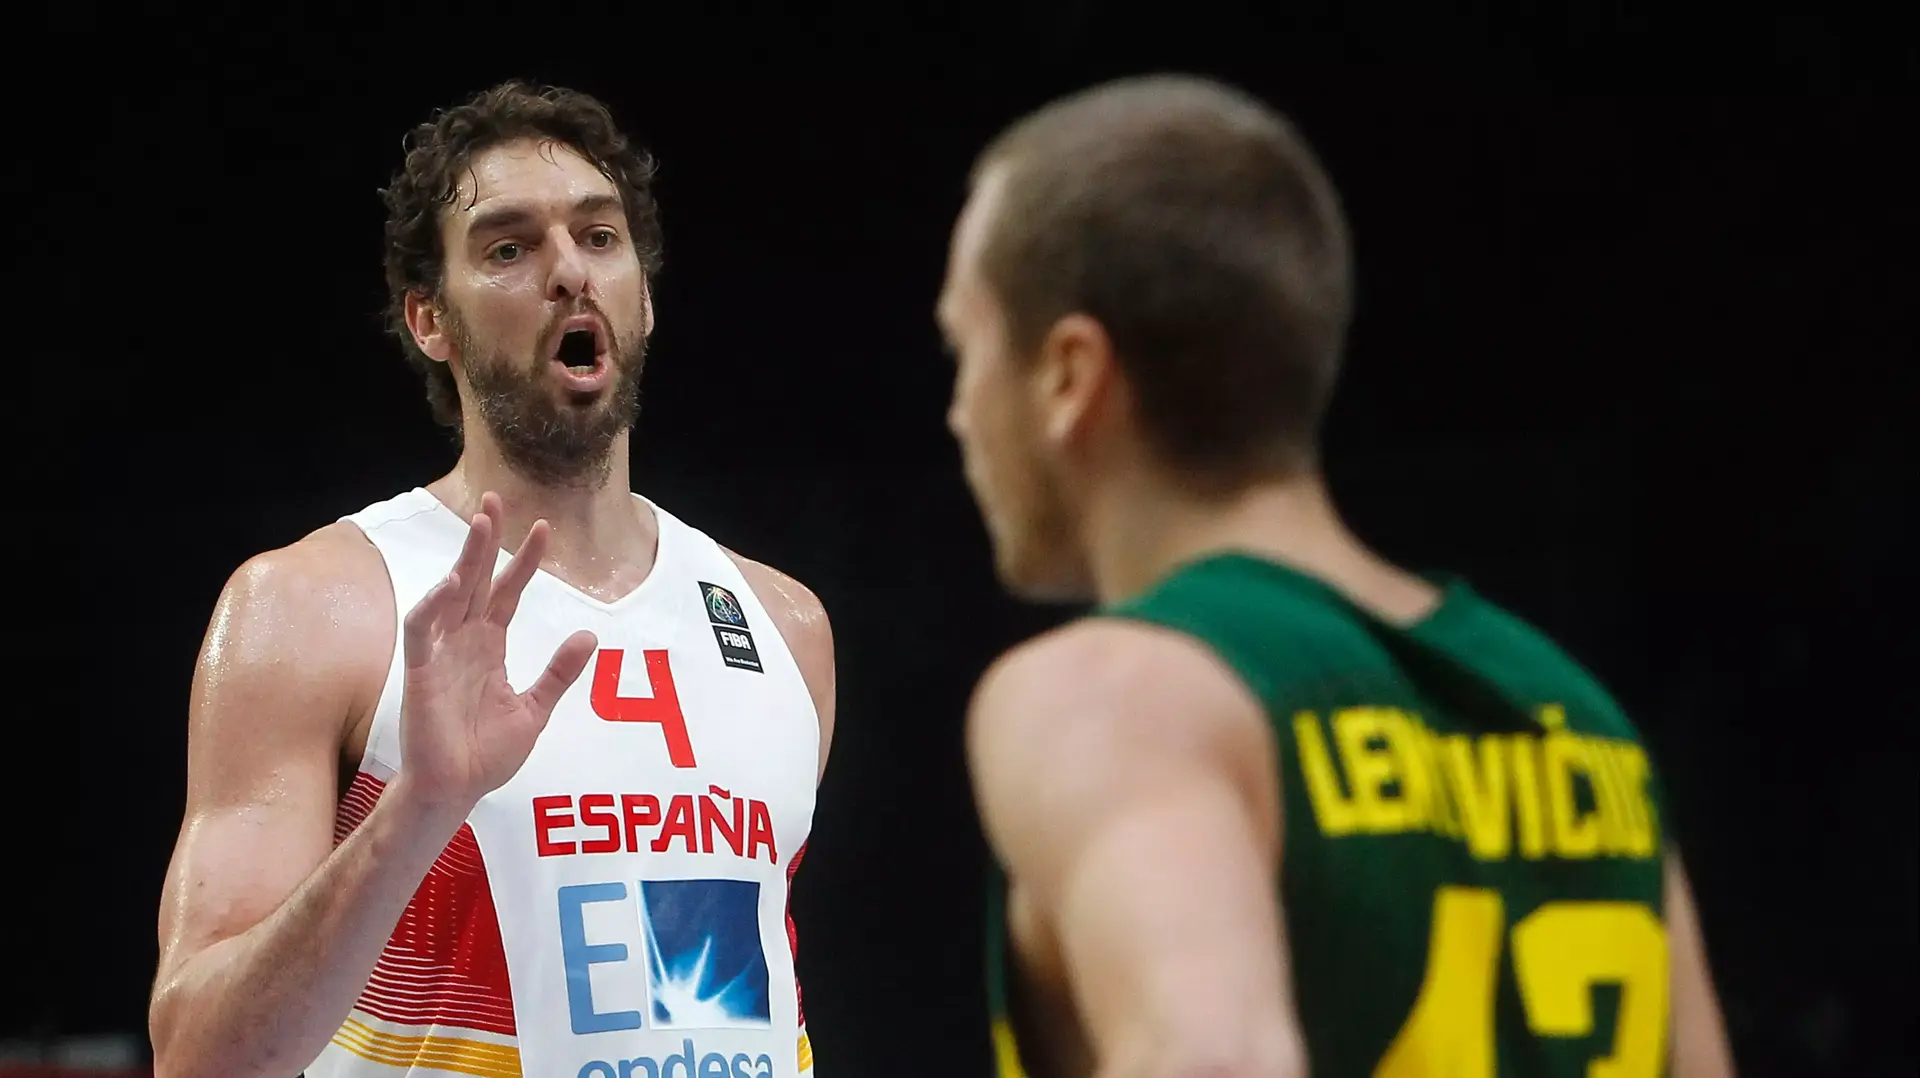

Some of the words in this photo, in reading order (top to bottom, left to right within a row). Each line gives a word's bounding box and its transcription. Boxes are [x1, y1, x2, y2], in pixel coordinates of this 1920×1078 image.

[720, 631, 752, 650] FIBA
[590, 649, 697, 768] 4
[533, 785, 778, 865] ESPAÑA
[1294, 704, 1655, 859] LEVIČIUS
